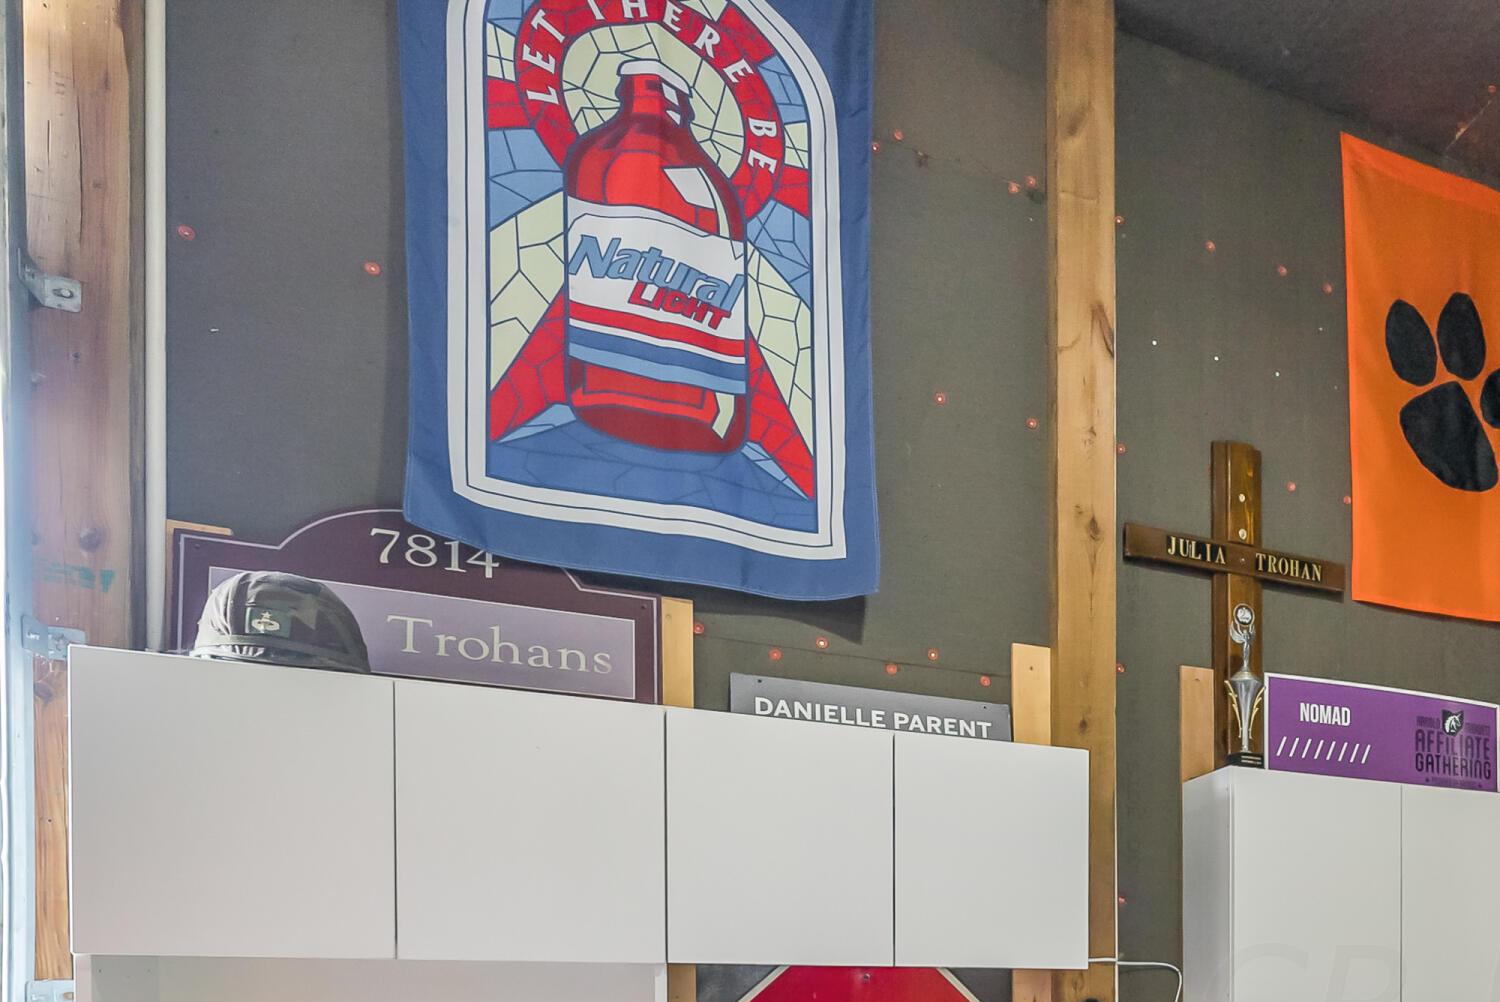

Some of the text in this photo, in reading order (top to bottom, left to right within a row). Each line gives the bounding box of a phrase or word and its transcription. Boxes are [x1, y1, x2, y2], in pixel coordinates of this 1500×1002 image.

[522, 9, 566, 105] LET
[747, 117, 778, 174] BE
[568, 234, 746, 312] Natural
[369, 527, 500, 579] 7814
[1167, 535, 1322, 582] JULIA TROHAN
[386, 615, 613, 675] Trohans
[754, 696, 992, 739] DANIELLE PARENT
[1299, 701, 1351, 728] NOMAD
[1415, 729, 1490, 760] AFFILIATE
[1415, 753, 1491, 780] GATHERING
